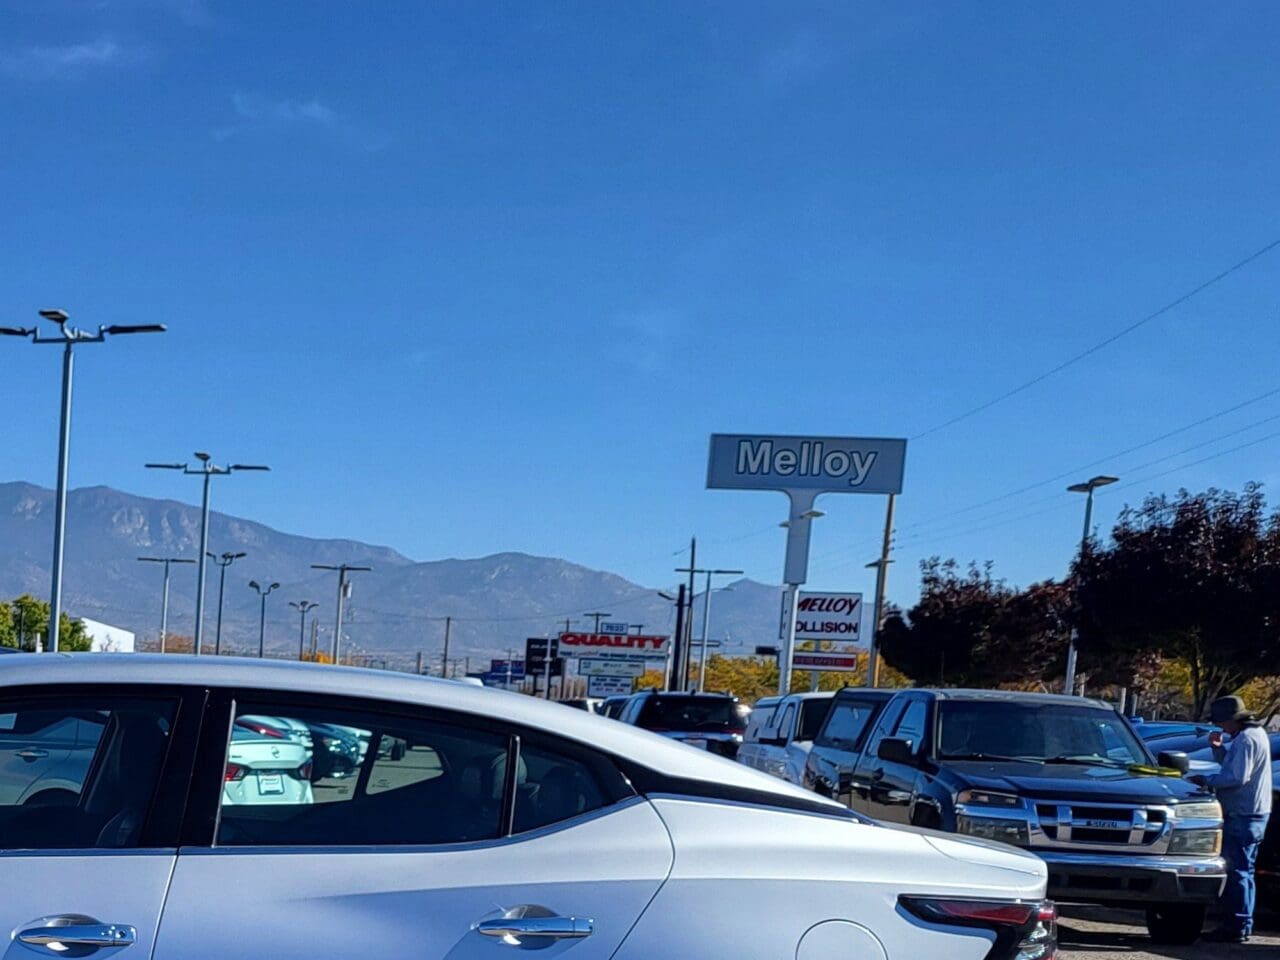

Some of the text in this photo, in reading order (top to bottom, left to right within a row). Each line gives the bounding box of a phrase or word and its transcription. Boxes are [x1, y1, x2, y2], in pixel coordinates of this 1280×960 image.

[736, 439, 878, 487] Melloy
[794, 621, 858, 633] OLLISION
[560, 633, 666, 649] QUALITY
